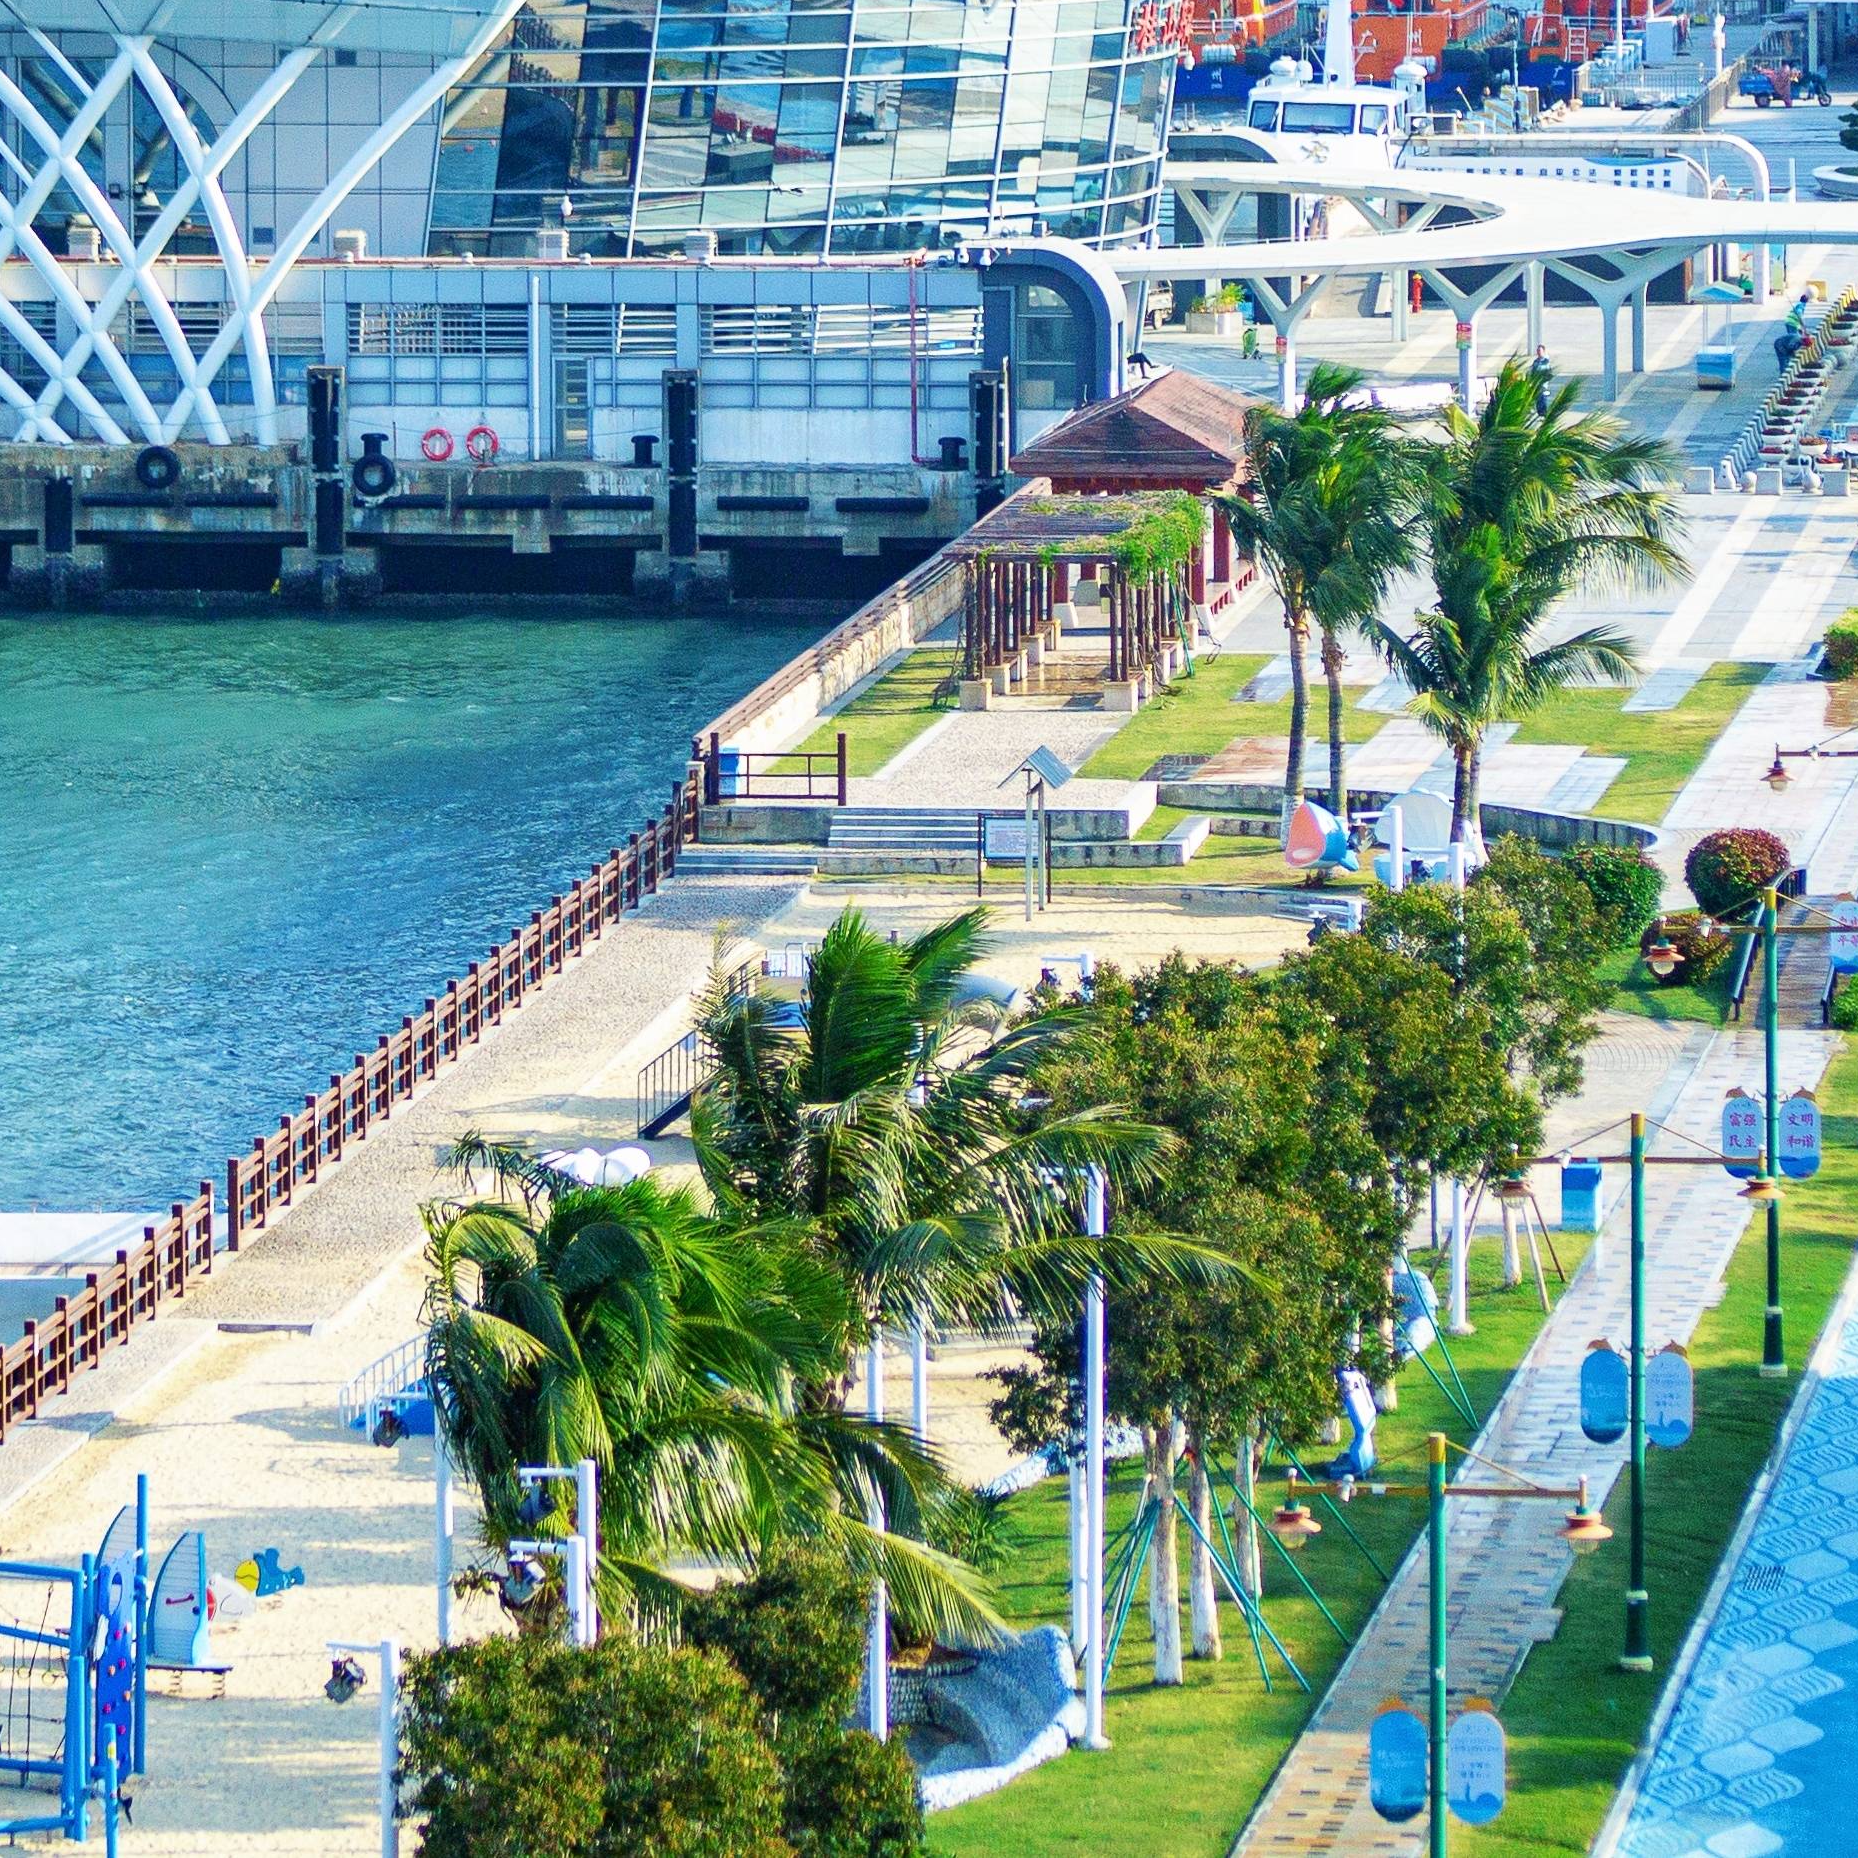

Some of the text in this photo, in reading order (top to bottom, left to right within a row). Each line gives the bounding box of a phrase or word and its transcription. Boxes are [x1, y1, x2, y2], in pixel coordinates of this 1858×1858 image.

[1729, 1112, 1756, 1127] 富强
[1788, 1112, 1813, 1127] 文明
[1729, 1134, 1756, 1148] 民主
[1787, 1134, 1813, 1148] 和谐
